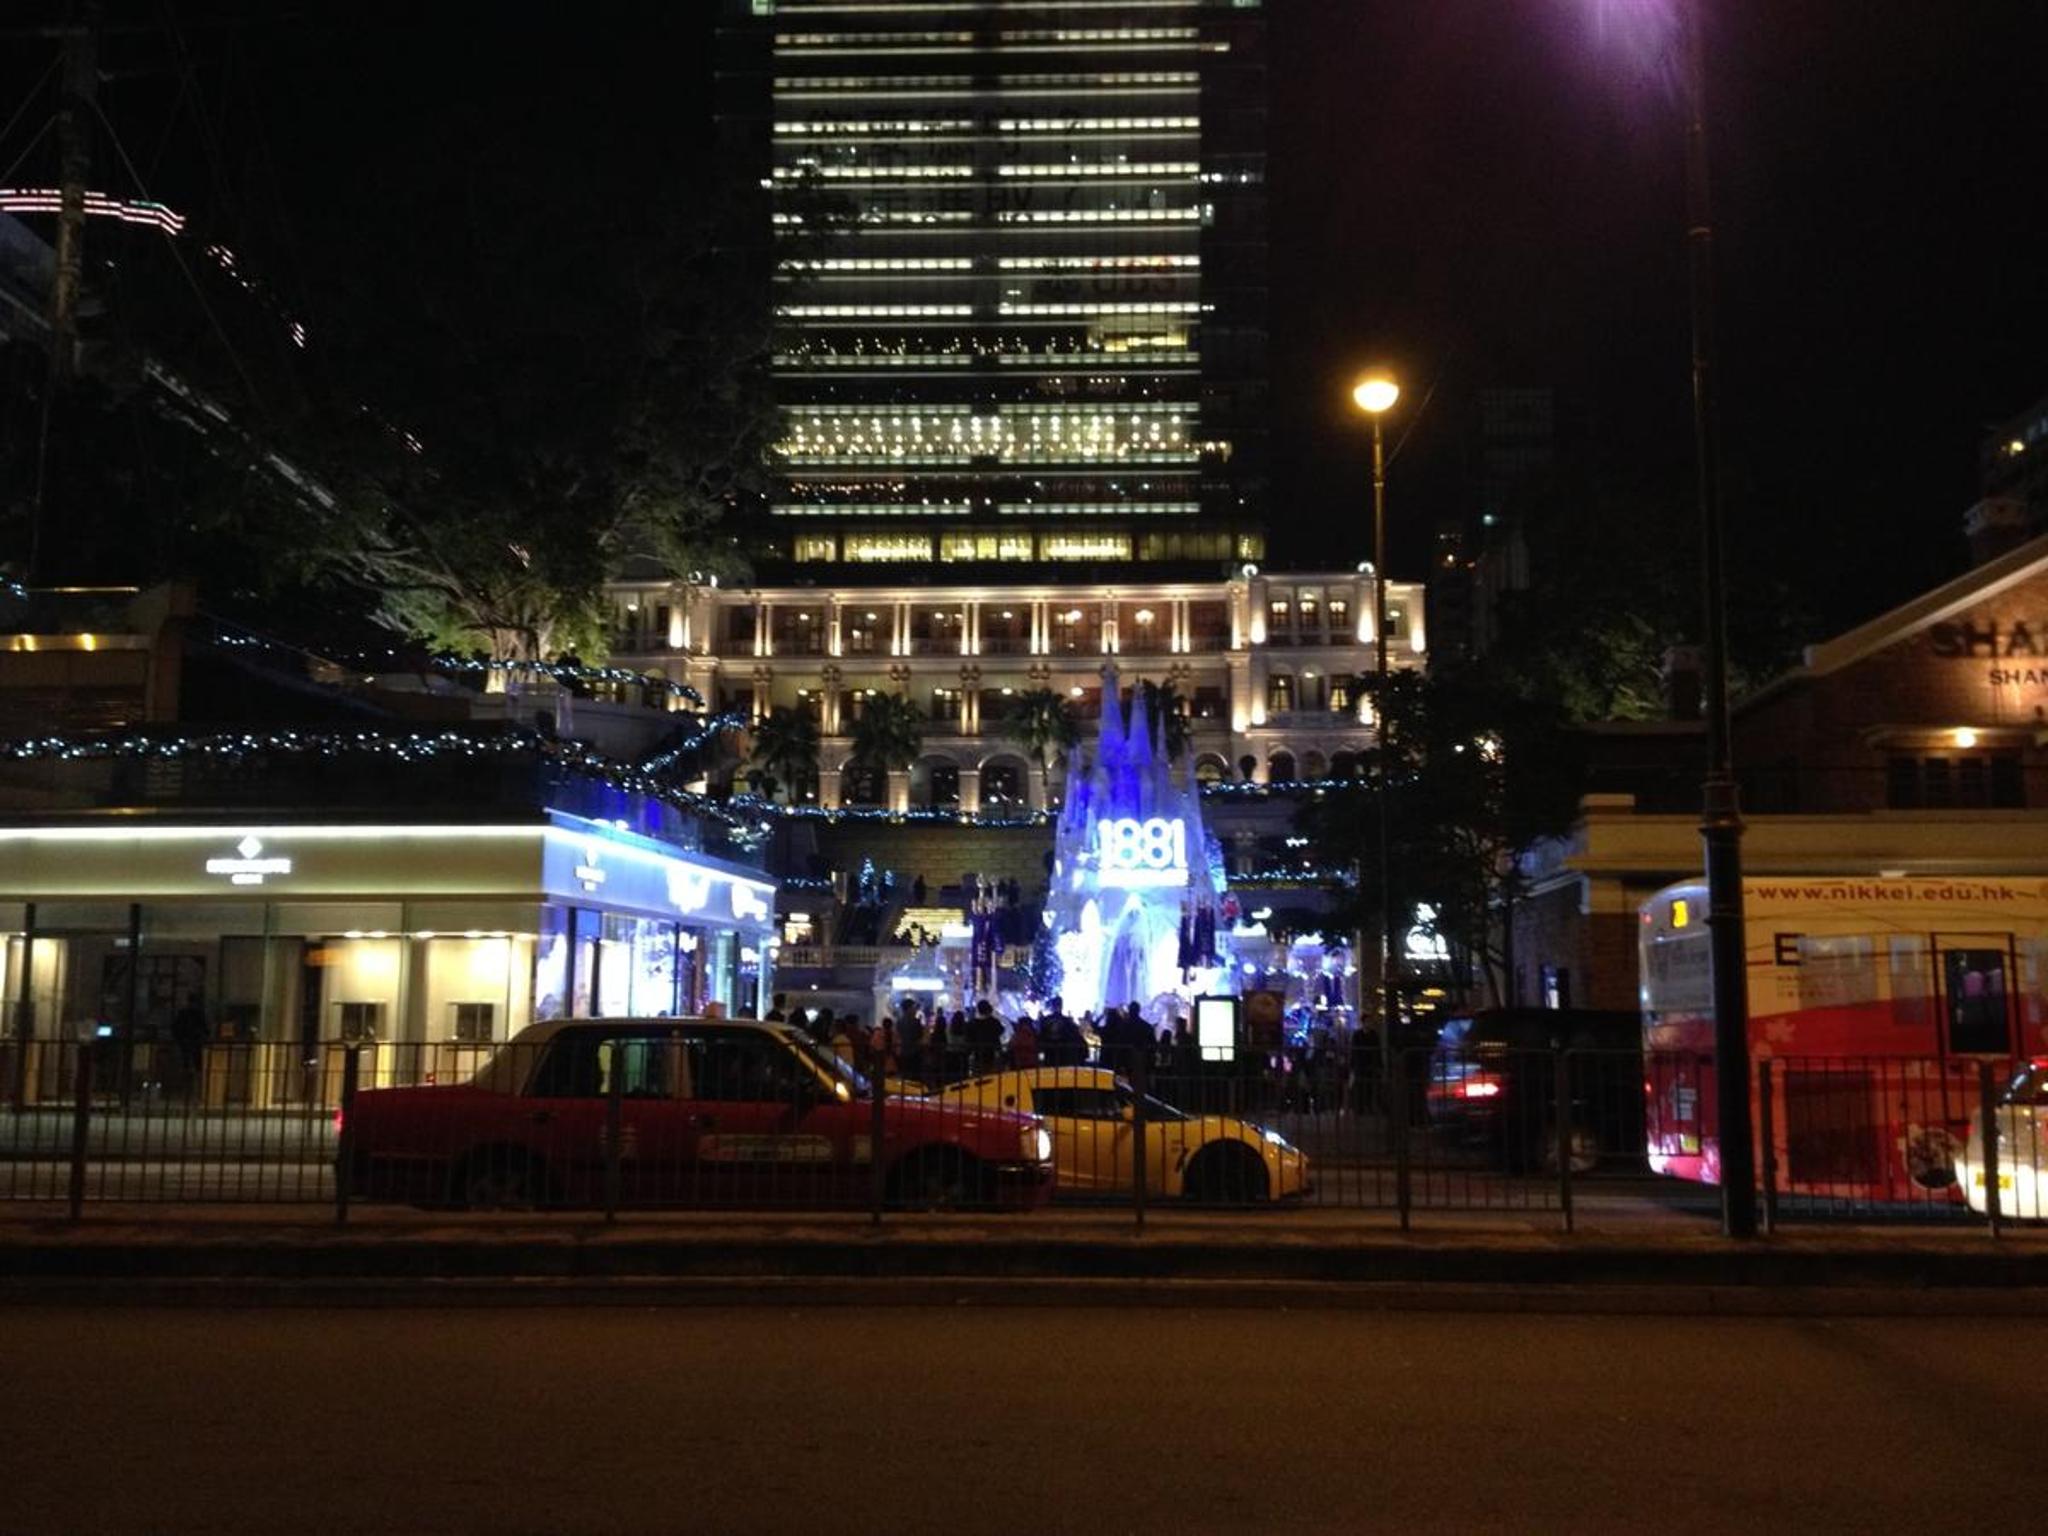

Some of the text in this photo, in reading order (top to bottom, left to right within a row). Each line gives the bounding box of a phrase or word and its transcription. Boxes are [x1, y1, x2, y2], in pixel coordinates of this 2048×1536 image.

[1932, 621, 2048, 657] SHA
[1098, 818, 1187, 867] 1881
[1757, 884, 2014, 901] www.nikkei.edu.hk
